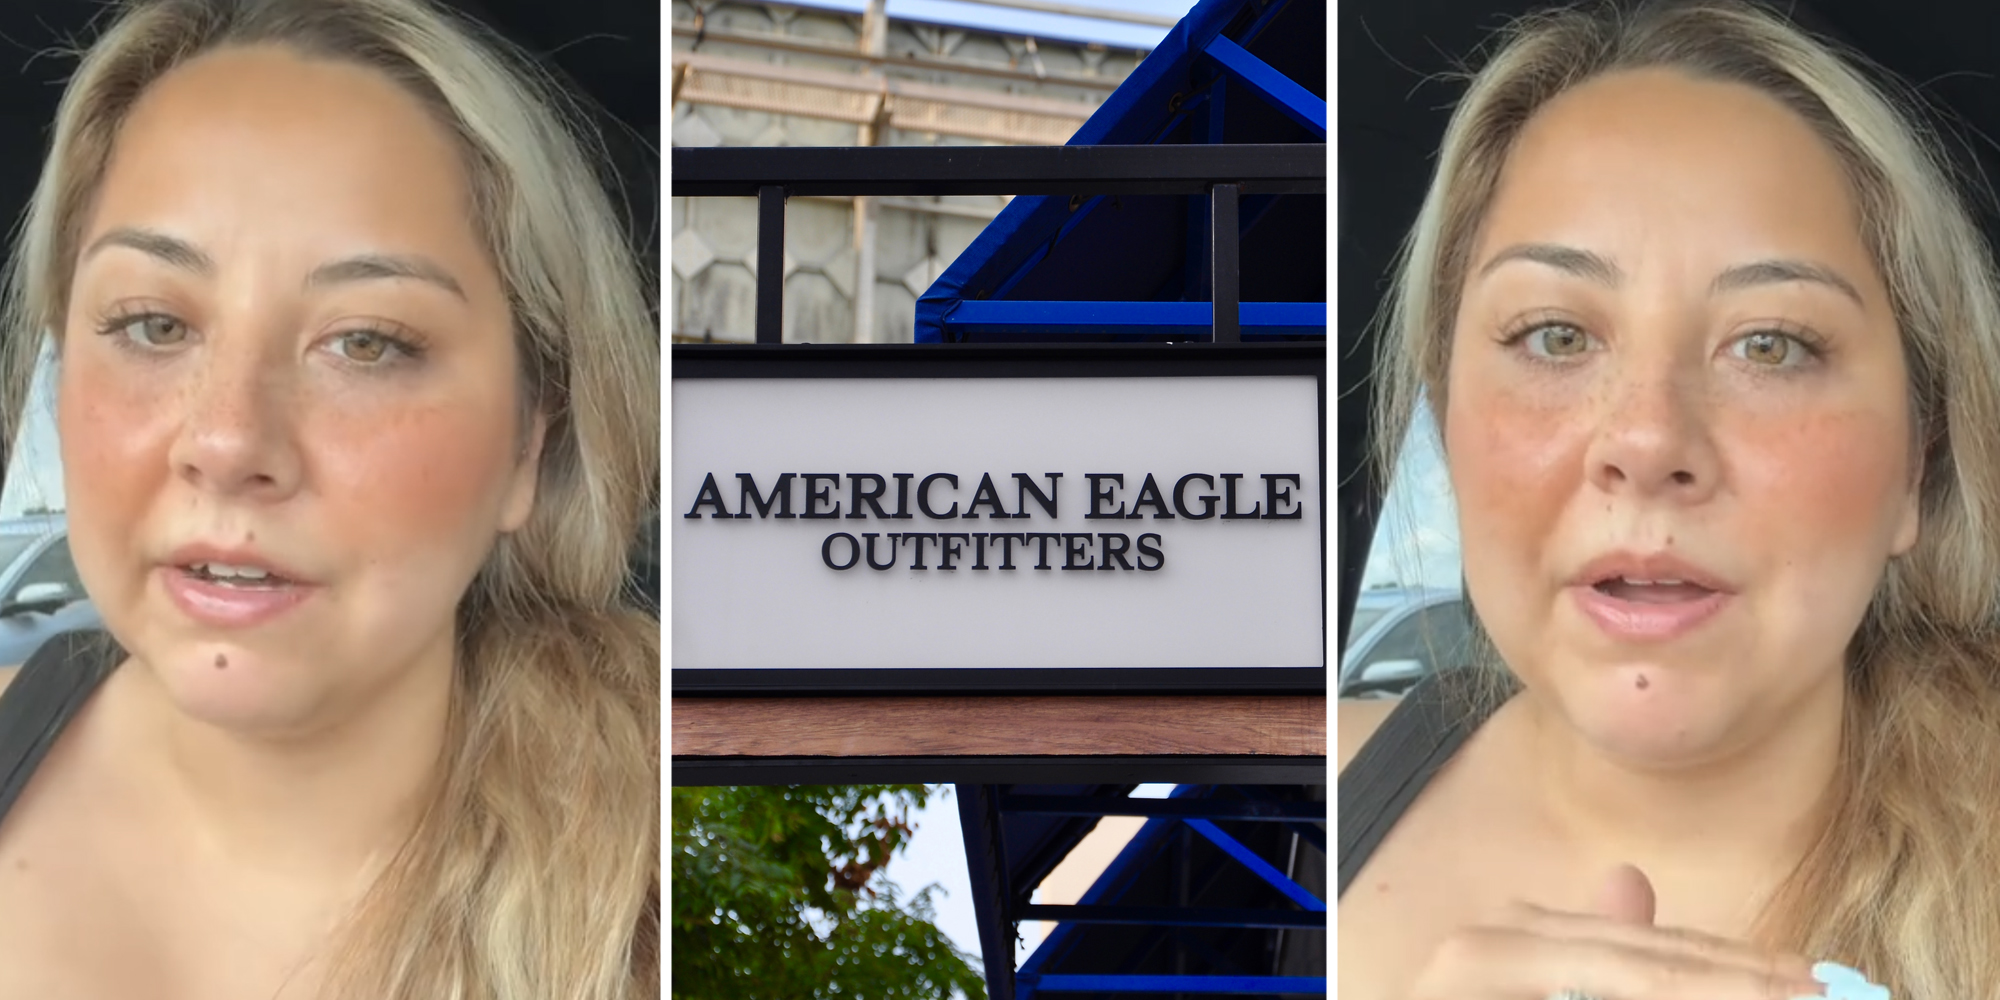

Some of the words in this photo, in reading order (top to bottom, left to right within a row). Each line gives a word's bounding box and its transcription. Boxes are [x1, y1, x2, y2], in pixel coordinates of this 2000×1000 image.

[684, 472, 1063, 520] AMERICAN
[1084, 472, 1303, 520] EAGLE
[821, 532, 1165, 571] OUTFITTERS
